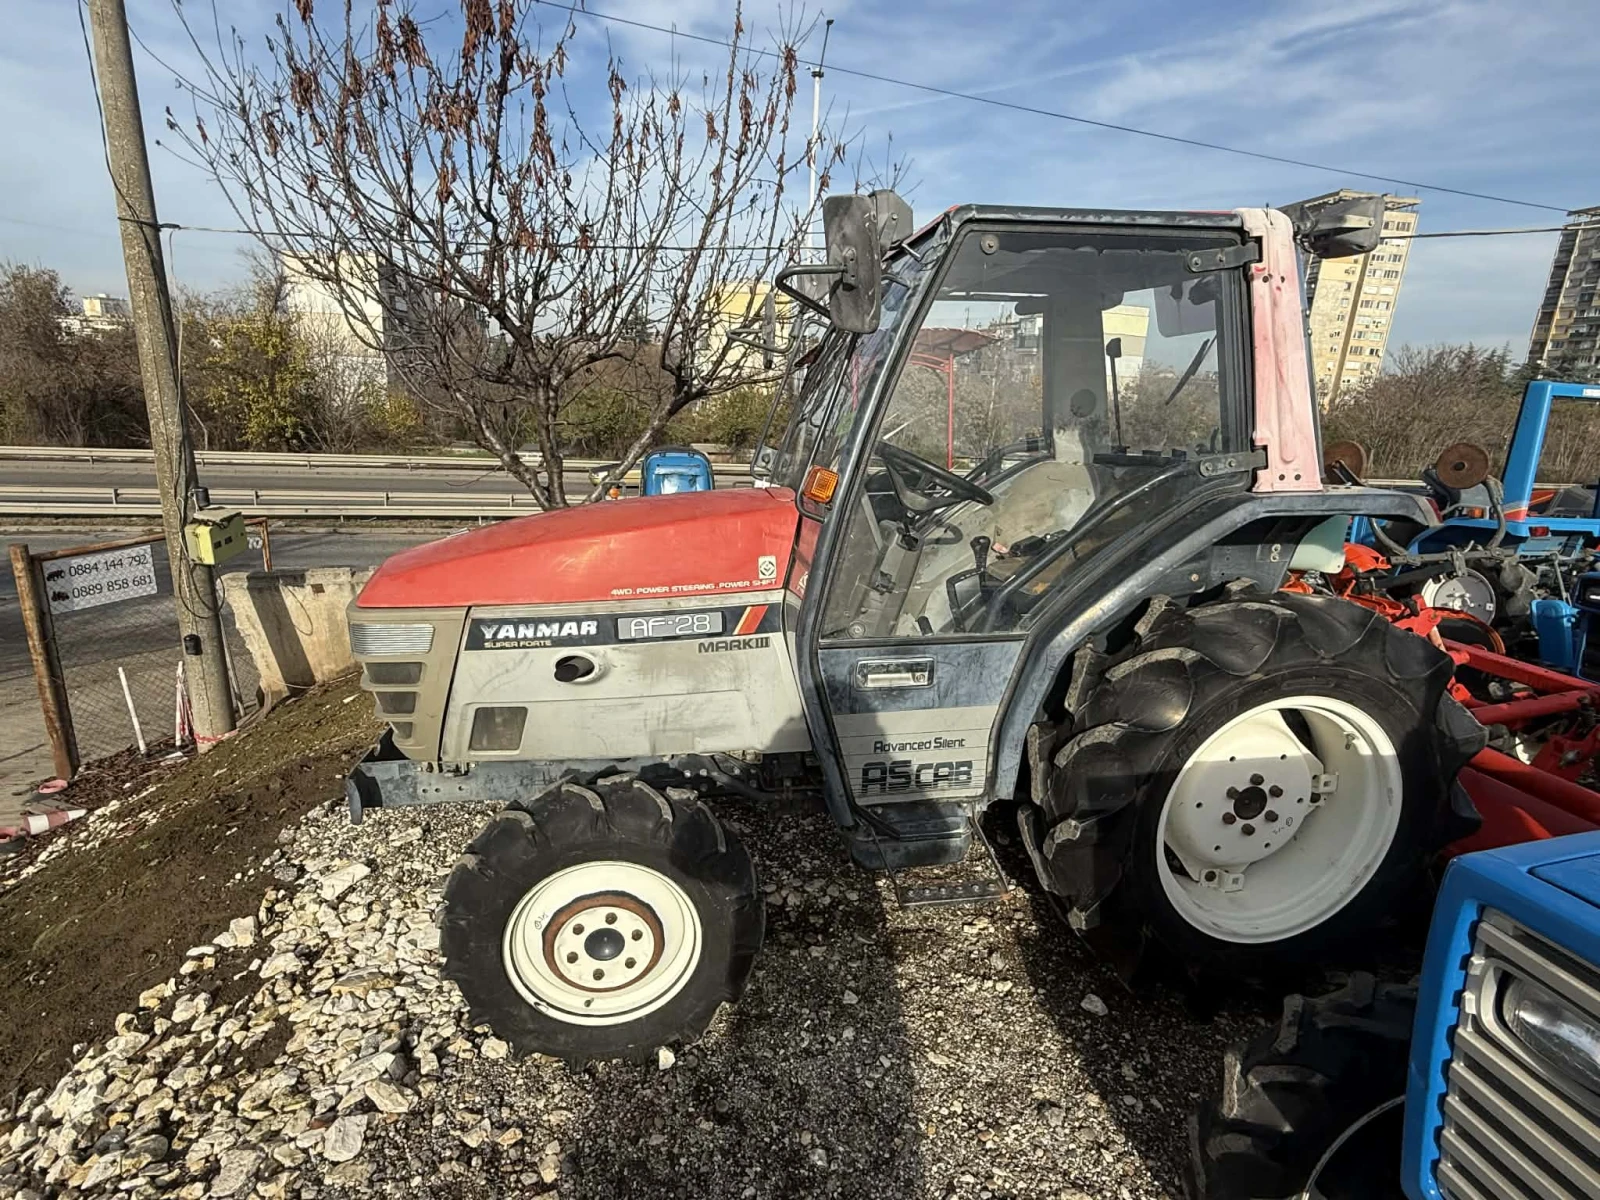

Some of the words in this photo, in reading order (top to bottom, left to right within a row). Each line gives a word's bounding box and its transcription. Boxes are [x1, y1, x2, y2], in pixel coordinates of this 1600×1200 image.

[69, 564, 99, 578] 0884
[104, 558, 124, 571] 144
[128, 554, 149, 567] 792
[72, 584, 103, 599] 0889
[107, 578, 130, 592] 858
[133, 574, 153, 588] 681
[637, 586, 669, 594] POWER
[752, 578, 777, 586] SHIFT
[480, 620, 598, 639] YANMAR
[484, 640, 518, 648] SUPER
[520, 639, 552, 647] FORTE
[873, 740, 932, 753] Advanced
[933, 737, 966, 749] Silent
